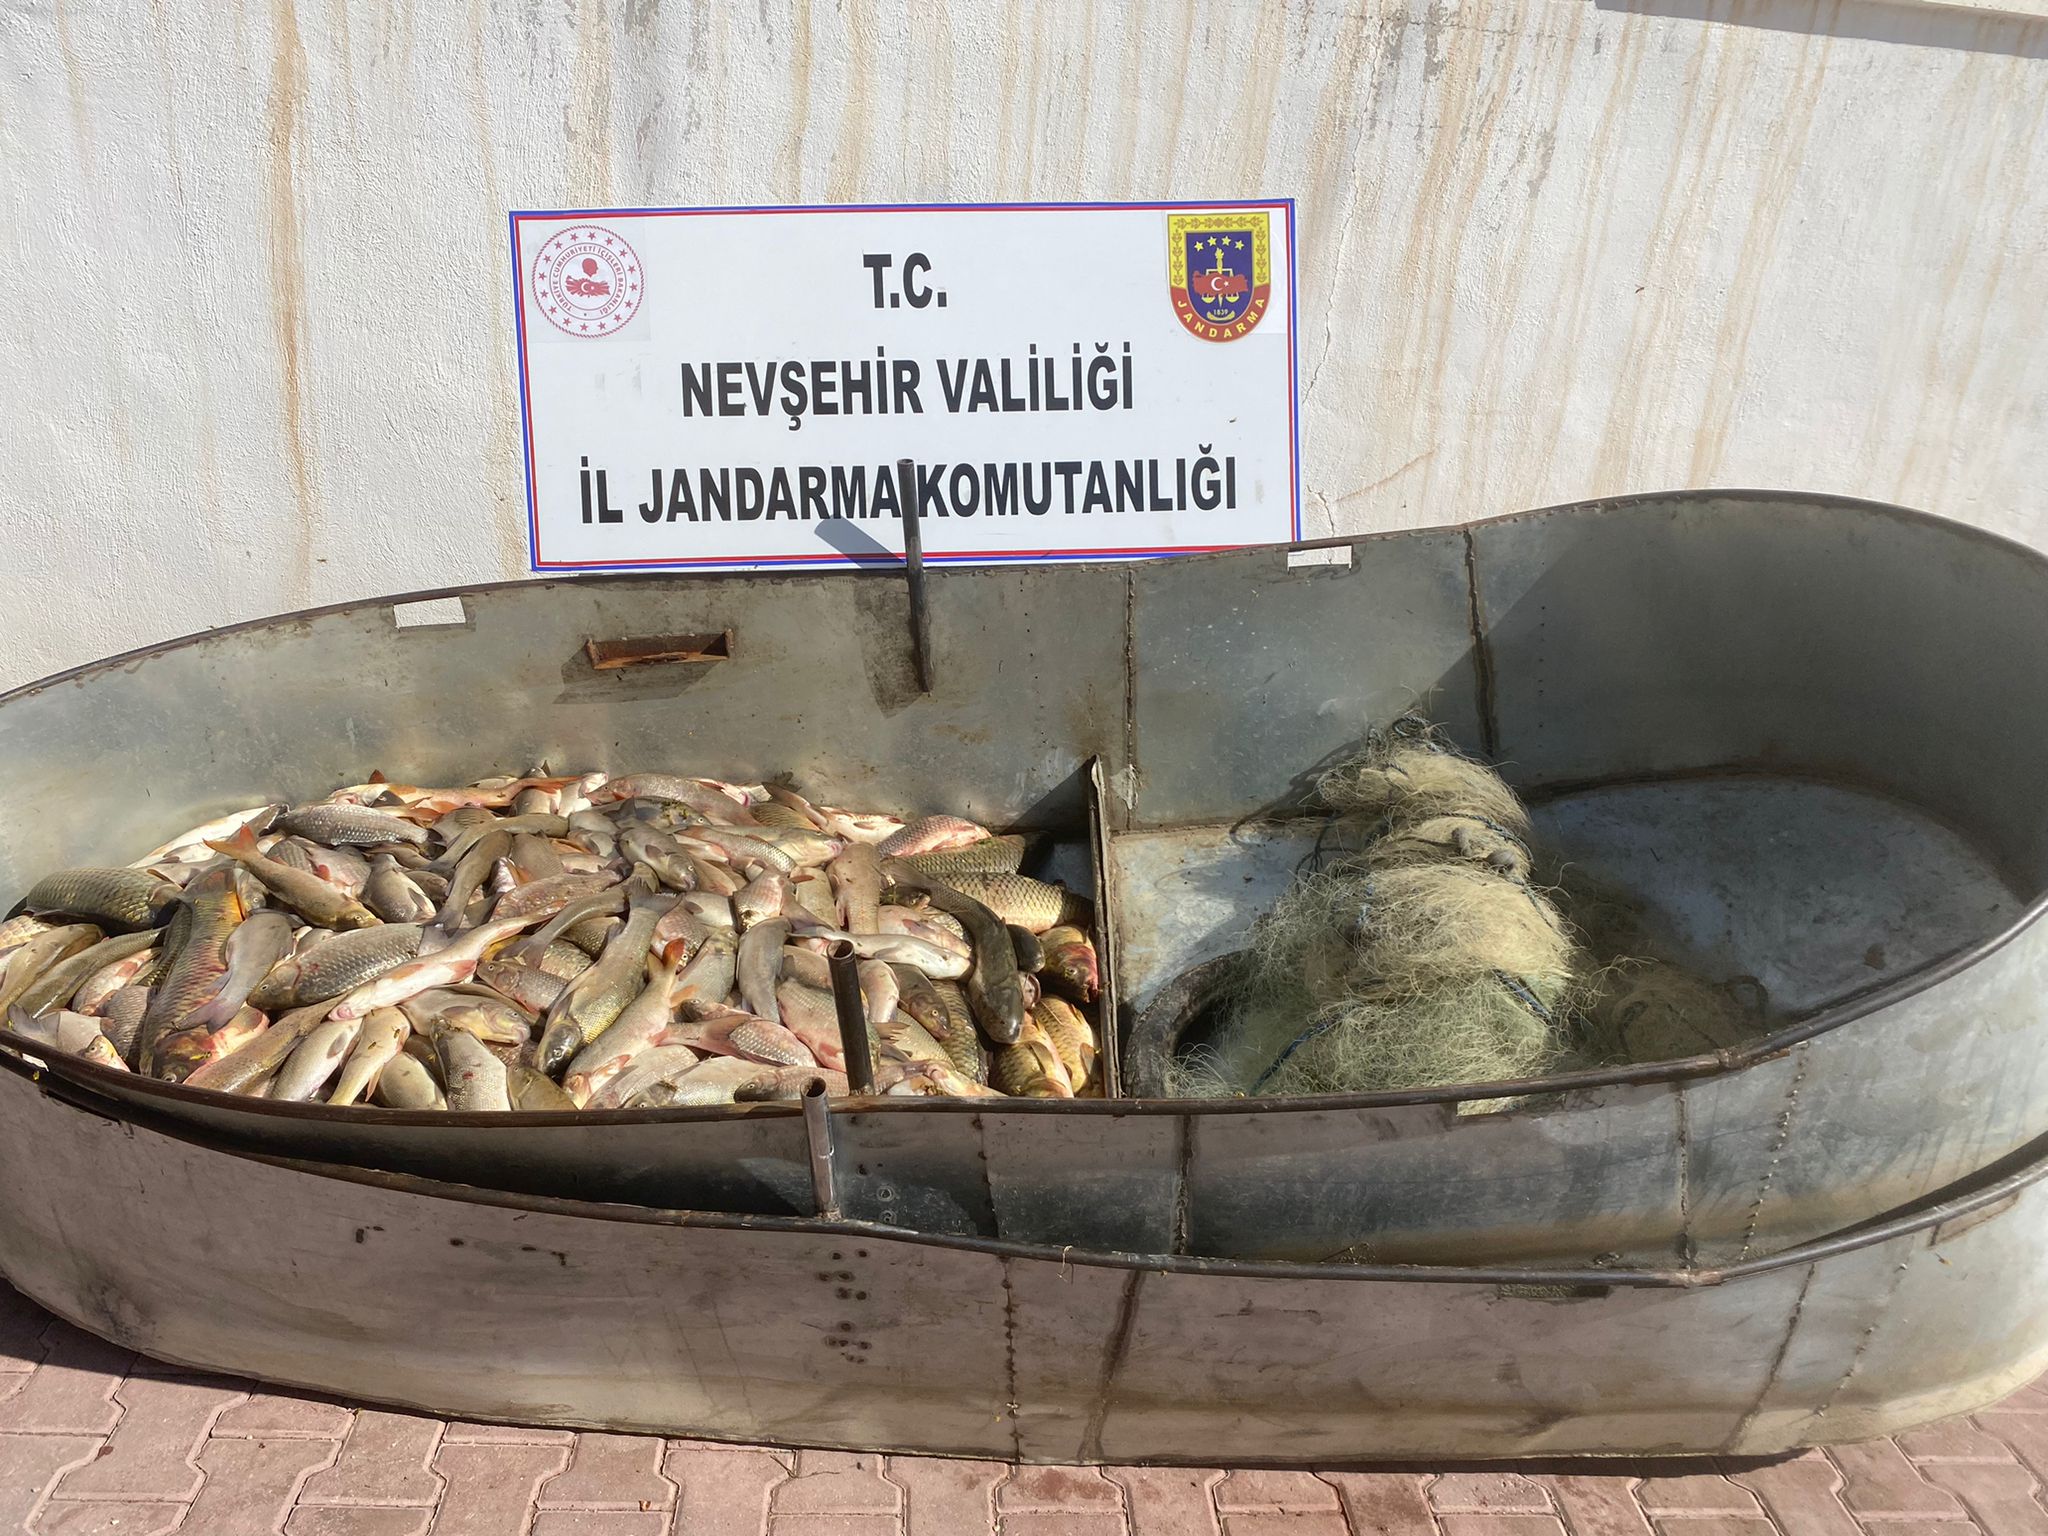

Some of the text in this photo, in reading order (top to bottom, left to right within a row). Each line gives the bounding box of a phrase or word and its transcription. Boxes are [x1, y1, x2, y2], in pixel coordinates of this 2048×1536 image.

[863, 252, 947, 309] T.C.
[1177, 298, 1265, 339] JANDARMA
[681, 341, 1133, 431] NEVŞEHİR VALİLİĞİ
[580, 443, 1236, 524] İL JANDARMA KOMUTANLIĞI
